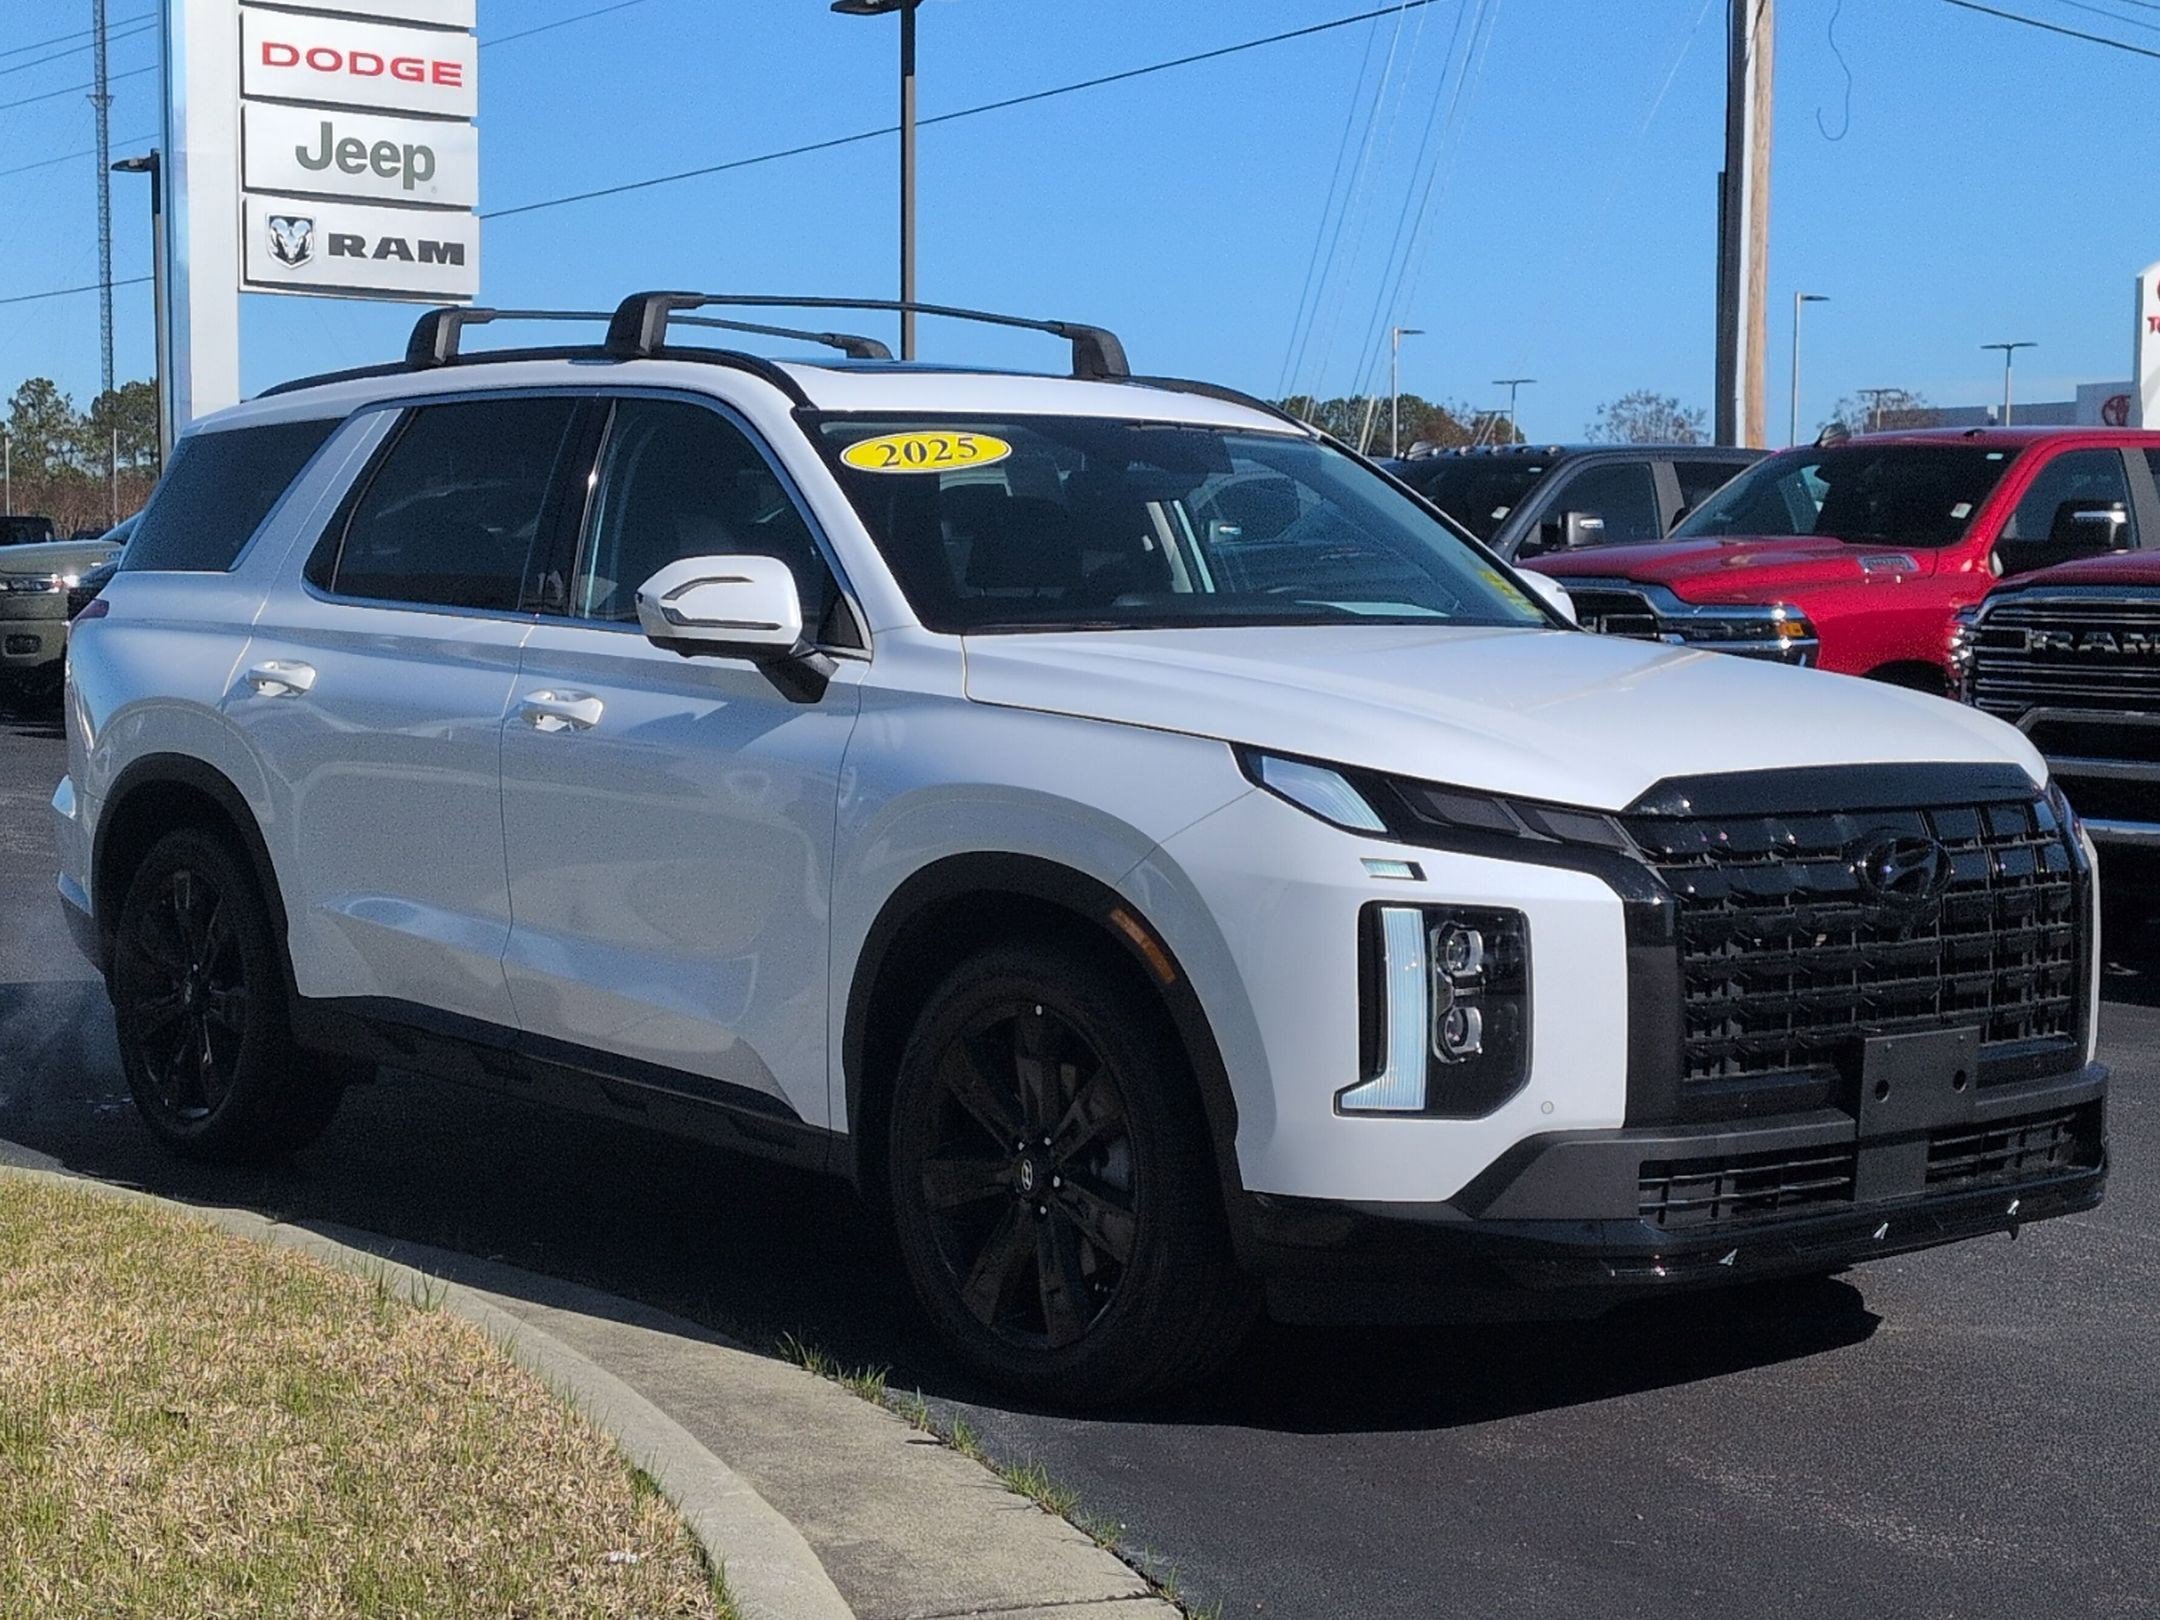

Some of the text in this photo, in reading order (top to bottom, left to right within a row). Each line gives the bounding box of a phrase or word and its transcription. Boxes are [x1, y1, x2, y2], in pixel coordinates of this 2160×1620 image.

[261, 41, 463, 87] DODGE
[295, 121, 435, 191] Jeep
[327, 232, 465, 267] RAM
[2146, 316, 2160, 335] T
[875, 436, 979, 468] 2025
[2029, 629, 2160, 653] RAM
